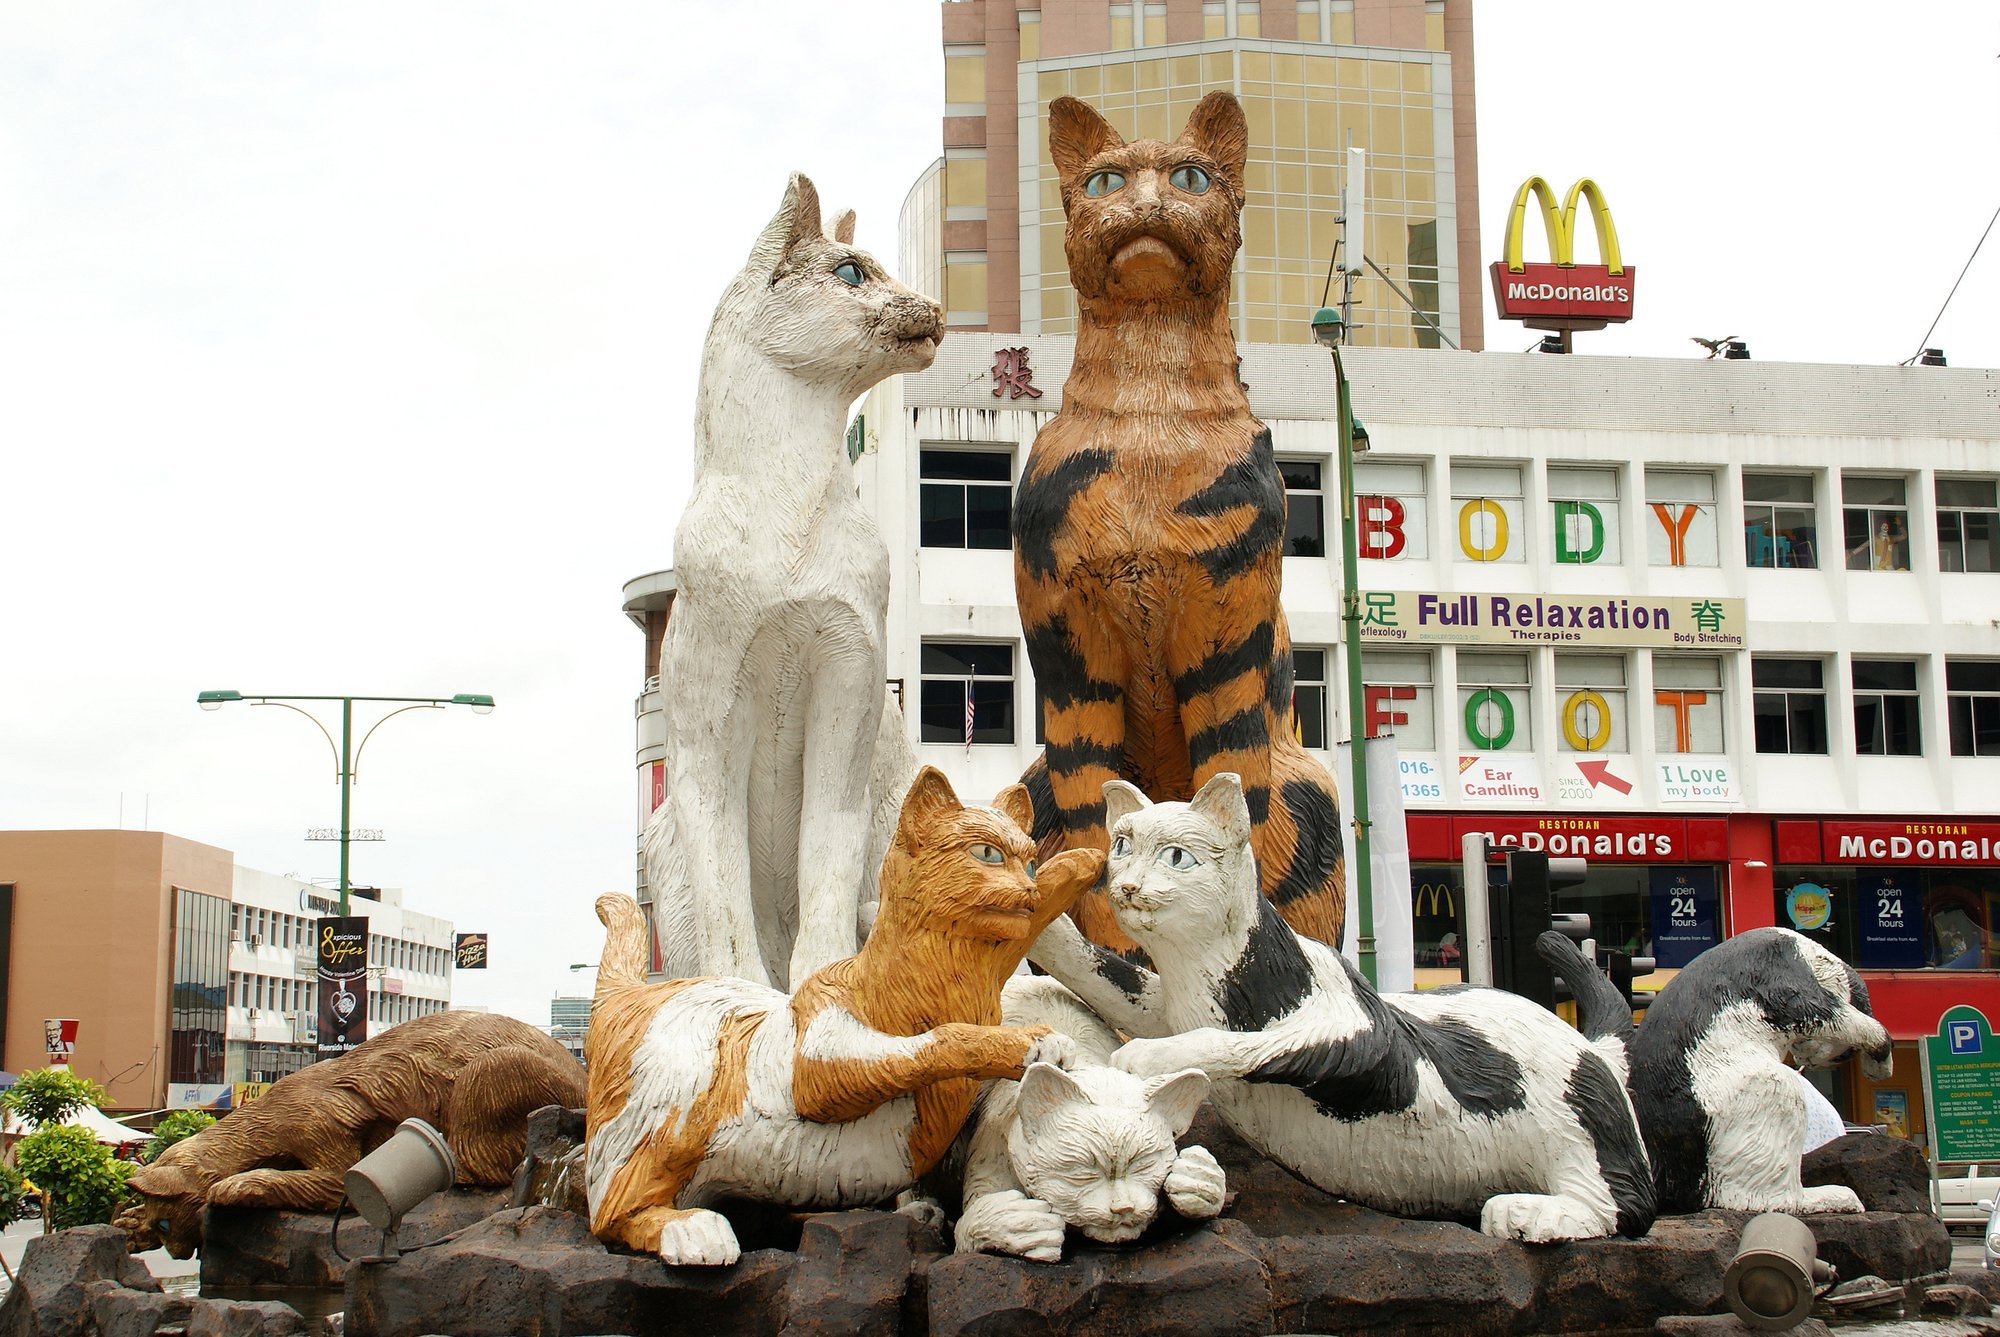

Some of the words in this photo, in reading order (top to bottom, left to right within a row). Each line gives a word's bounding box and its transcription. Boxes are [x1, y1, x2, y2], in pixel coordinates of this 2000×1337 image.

[1508, 283, 1629, 303] McDonald's
[1363, 592, 1399, 626] 足
[1418, 594, 1478, 626] Full
[1490, 596, 1670, 630] Relaxation
[1691, 600, 1725, 632] 脊
[1360, 627, 1407, 638] eflexology
[1510, 630, 1581, 641] Therapies
[1674, 633, 1695, 644] Body
[1698, 633, 1742, 645] Stretching
[1484, 769, 1513, 781] Ear
[1662, 766, 1673, 783] I
[1677, 766, 1728, 783] Love
[1559, 778, 1585, 786] SINCE
[1465, 783, 1540, 799] Candling
[1560, 788, 1593, 799] 2000
[1667, 787, 1688, 797] my
[1692, 786, 1729, 797] body
[1539, 820, 1600, 830] RESTORAN
[1906, 825, 1968, 835] RESTORAN
[1670, 888, 1696, 897] open
[1877, 889, 1902, 898] open
[1671, 898, 1697, 917] 24
[1878, 899, 1904, 918] 24
[1671, 917, 1698, 927] hours
[1879, 918, 1904, 928] hours
[456, 943, 486, 963] Pizza
[463, 951, 483, 966] Hut
[1953, 1026, 1974, 1049] P
[319, 1043, 343, 1051] Riverside
